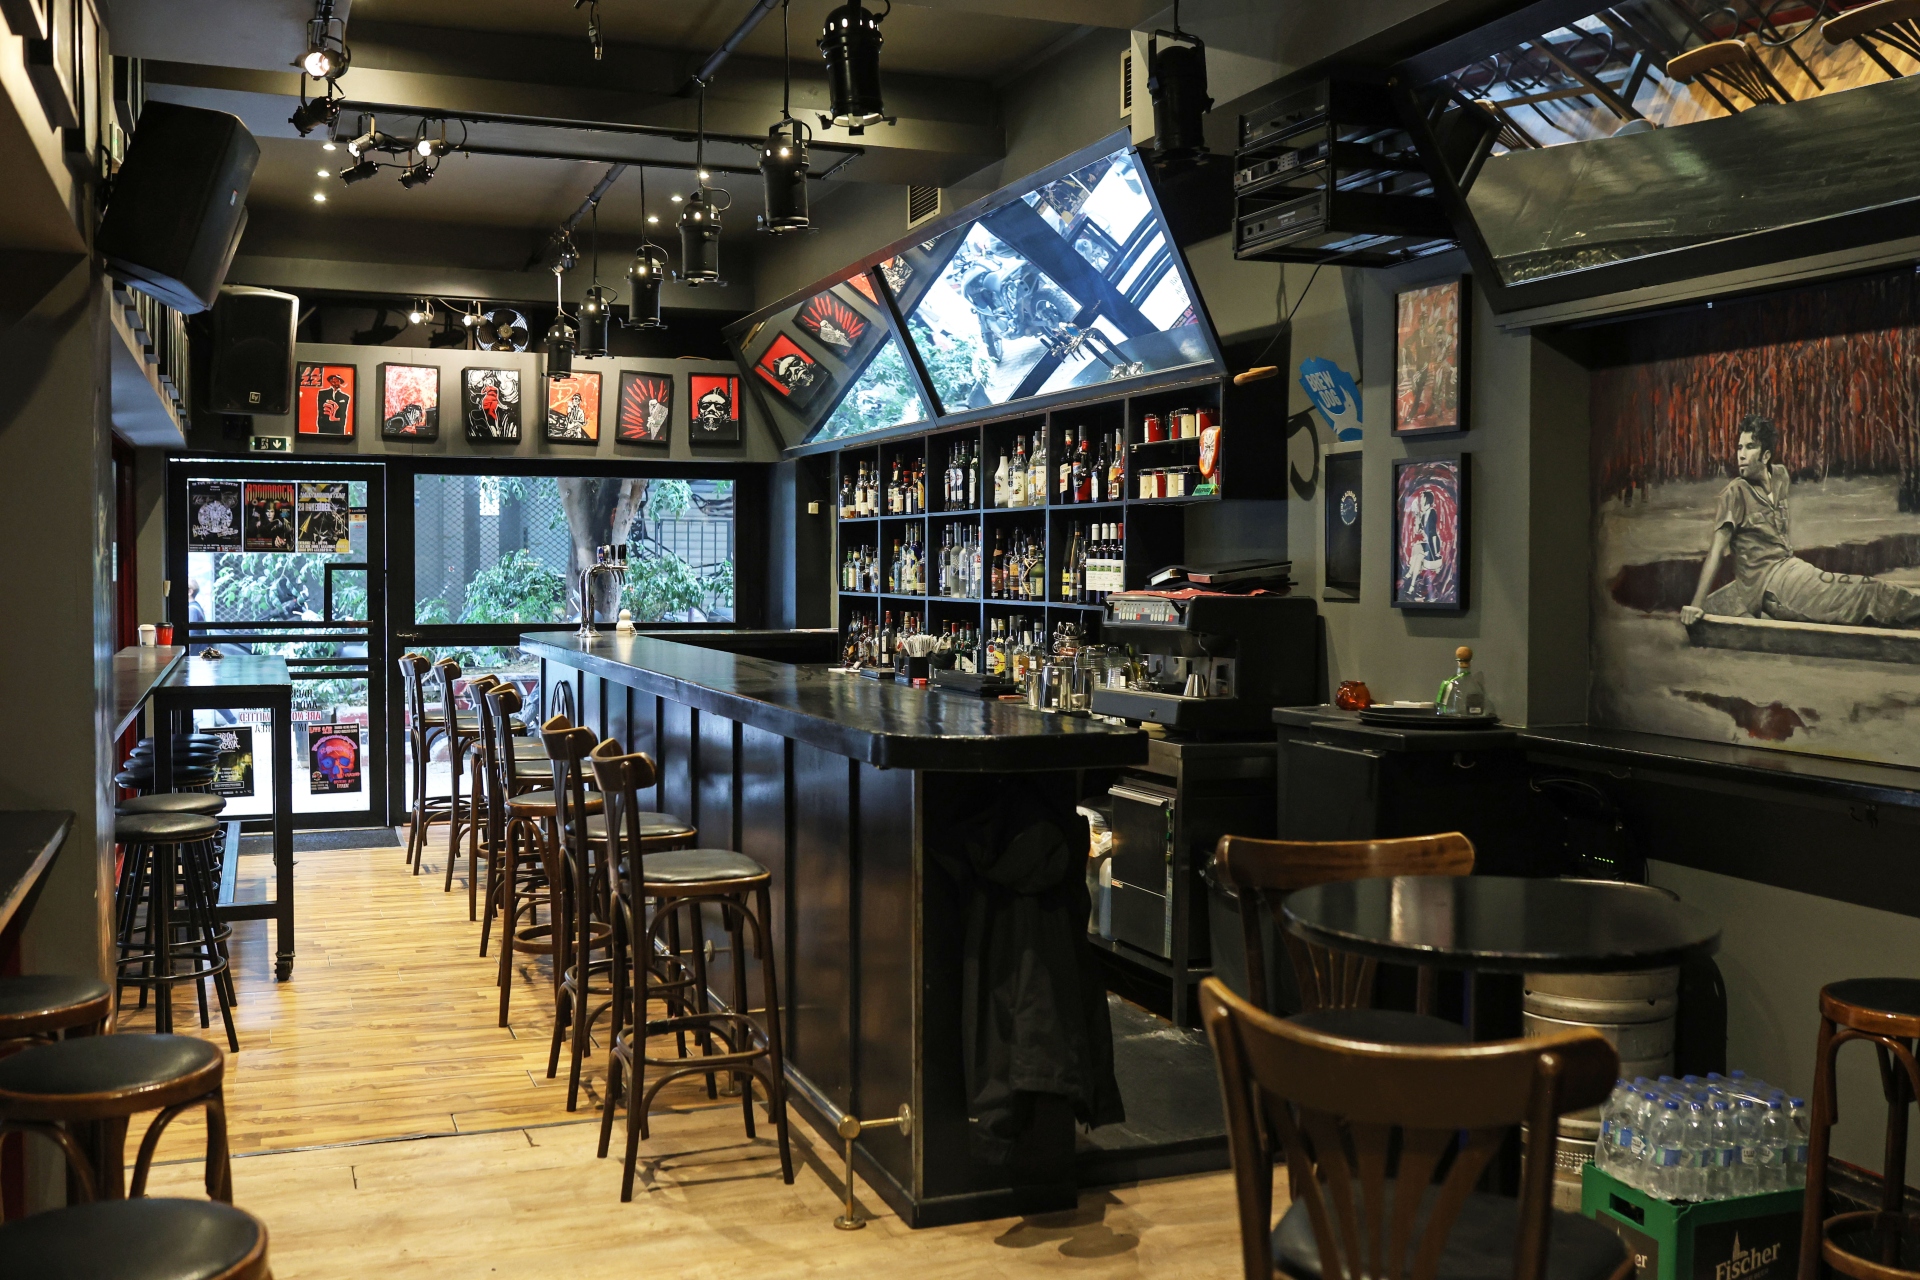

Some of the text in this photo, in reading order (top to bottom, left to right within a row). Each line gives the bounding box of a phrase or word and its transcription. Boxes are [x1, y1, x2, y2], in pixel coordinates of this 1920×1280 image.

[1304, 370, 1335, 392] BREW
[1318, 388, 1342, 408] DOG
[1715, 1242, 1781, 1280] Fischer
